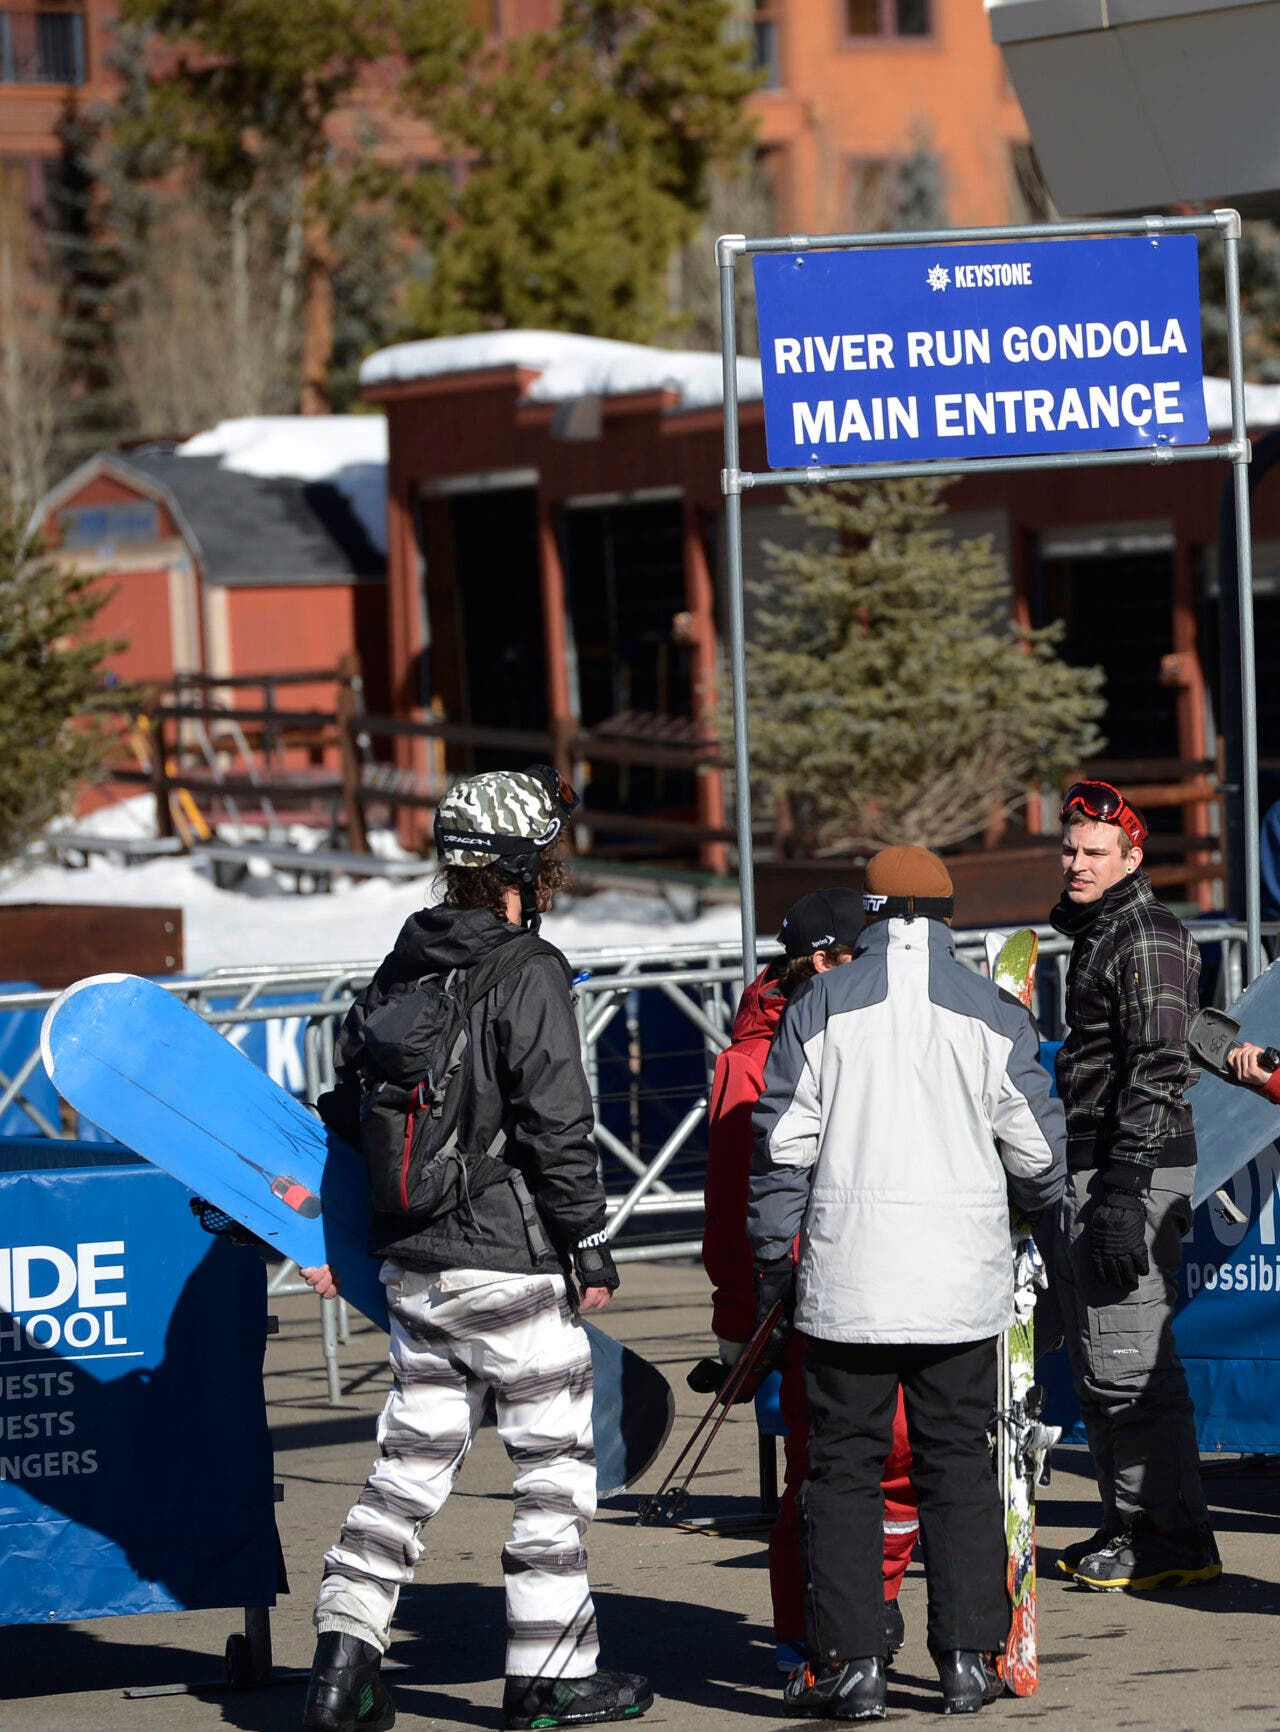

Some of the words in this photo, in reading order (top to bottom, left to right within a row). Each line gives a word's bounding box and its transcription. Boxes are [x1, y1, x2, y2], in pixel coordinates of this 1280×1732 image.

[954, 262, 1032, 289] KEYSTONE
[774, 333, 894, 374] RIVER
[907, 328, 990, 368] RUN
[1002, 318, 1187, 363] GONDOLA
[792, 395, 919, 445] MAIN
[934, 381, 1184, 437] ENTRANCE
[443, 835, 492, 846] DRAGON
[0, 1371, 75, 1401] ESTS
[0, 1411, 76, 1441] ESTS
